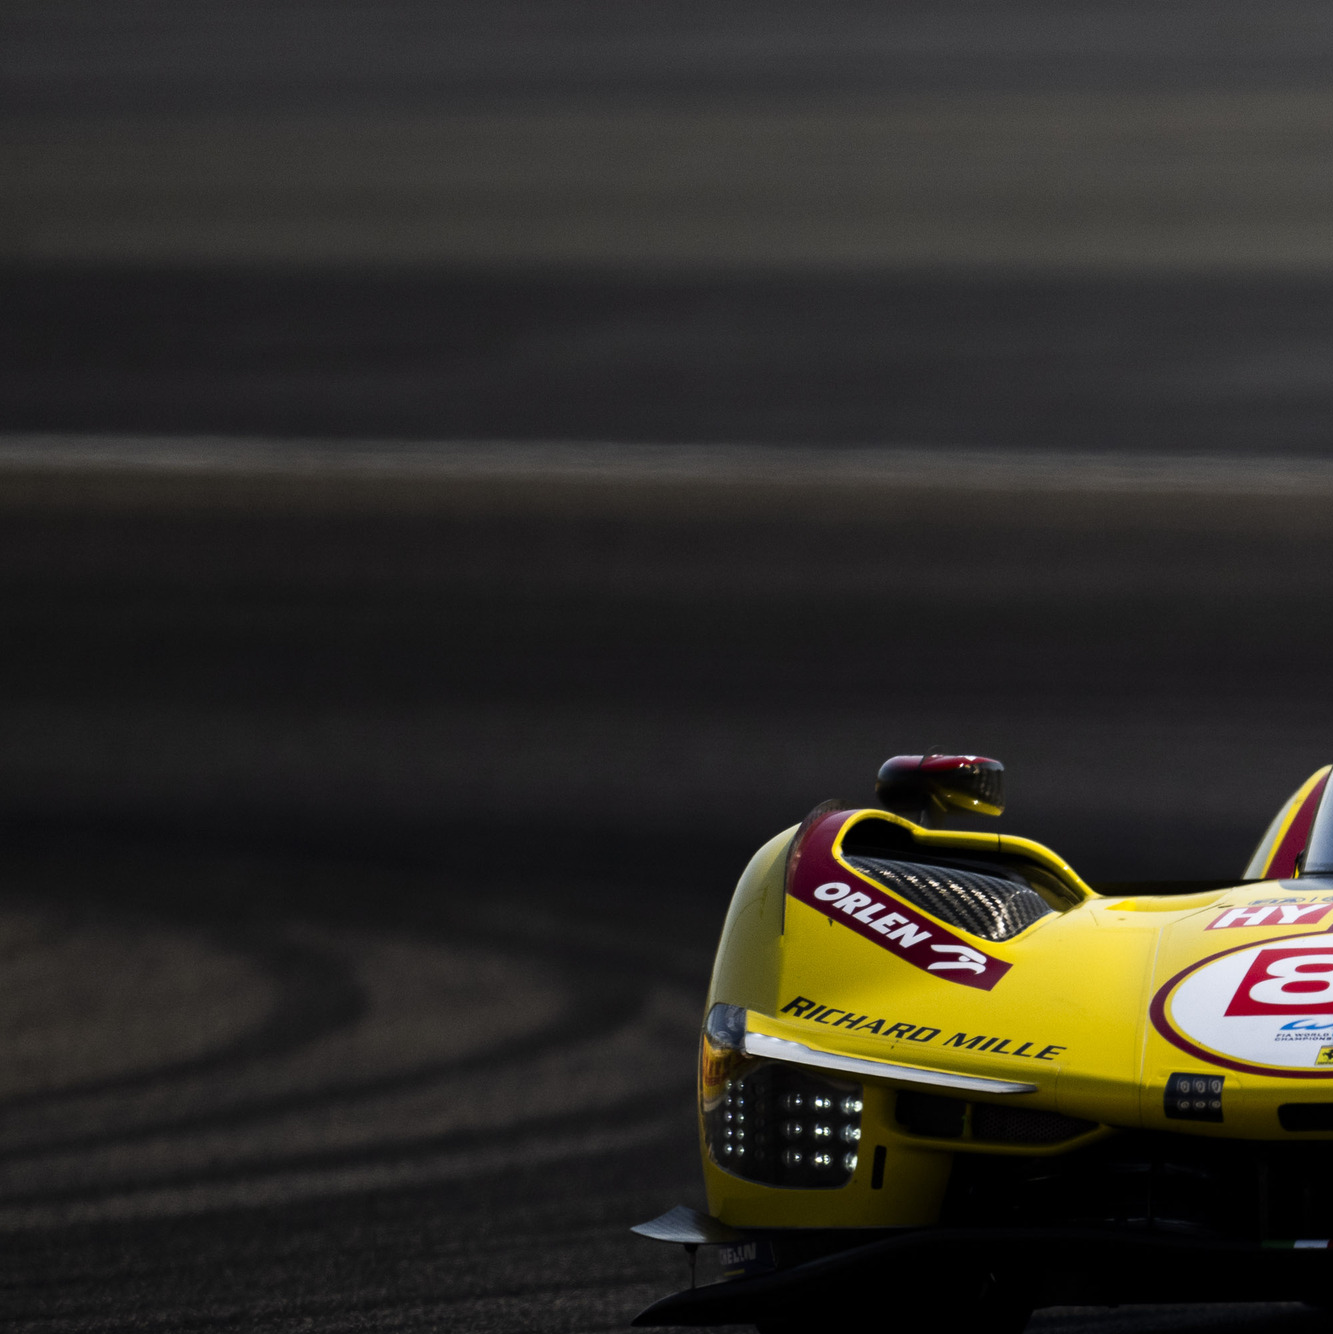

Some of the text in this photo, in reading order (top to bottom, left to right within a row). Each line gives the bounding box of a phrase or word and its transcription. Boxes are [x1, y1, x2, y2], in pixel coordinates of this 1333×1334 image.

[813, 881, 932, 949] ORLEN
[1213, 903, 1332, 929] HY
[780, 996, 1067, 1062] RICHARD MILLE
